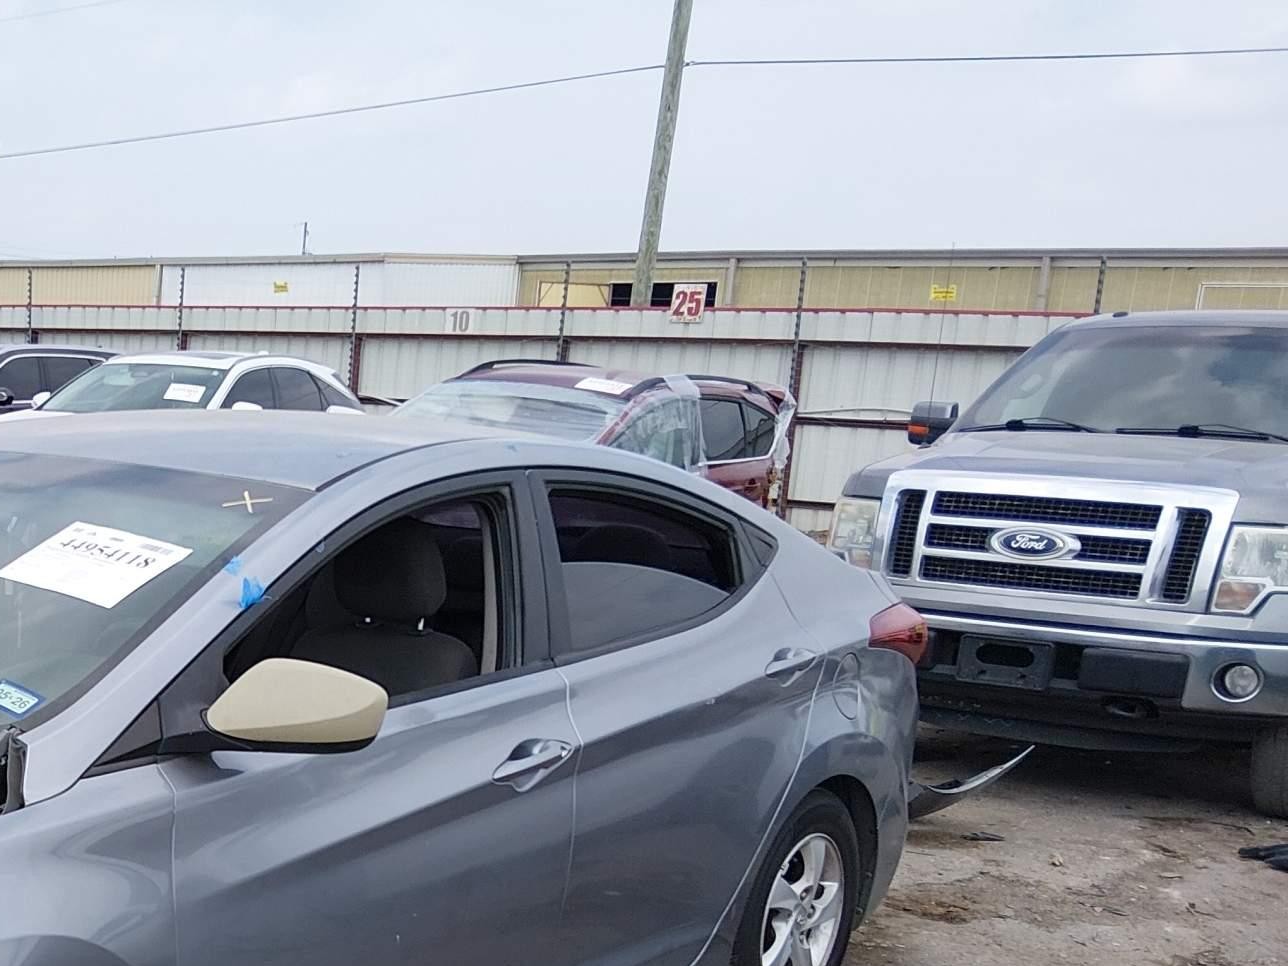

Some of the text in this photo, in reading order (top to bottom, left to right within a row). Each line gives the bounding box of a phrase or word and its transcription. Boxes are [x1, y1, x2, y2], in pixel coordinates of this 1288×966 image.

[671, 289, 702, 317] 25
[450, 311, 470, 332] 10
[59, 538, 156, 568] 44954118
[1011, 534, 1048, 550] Ford
